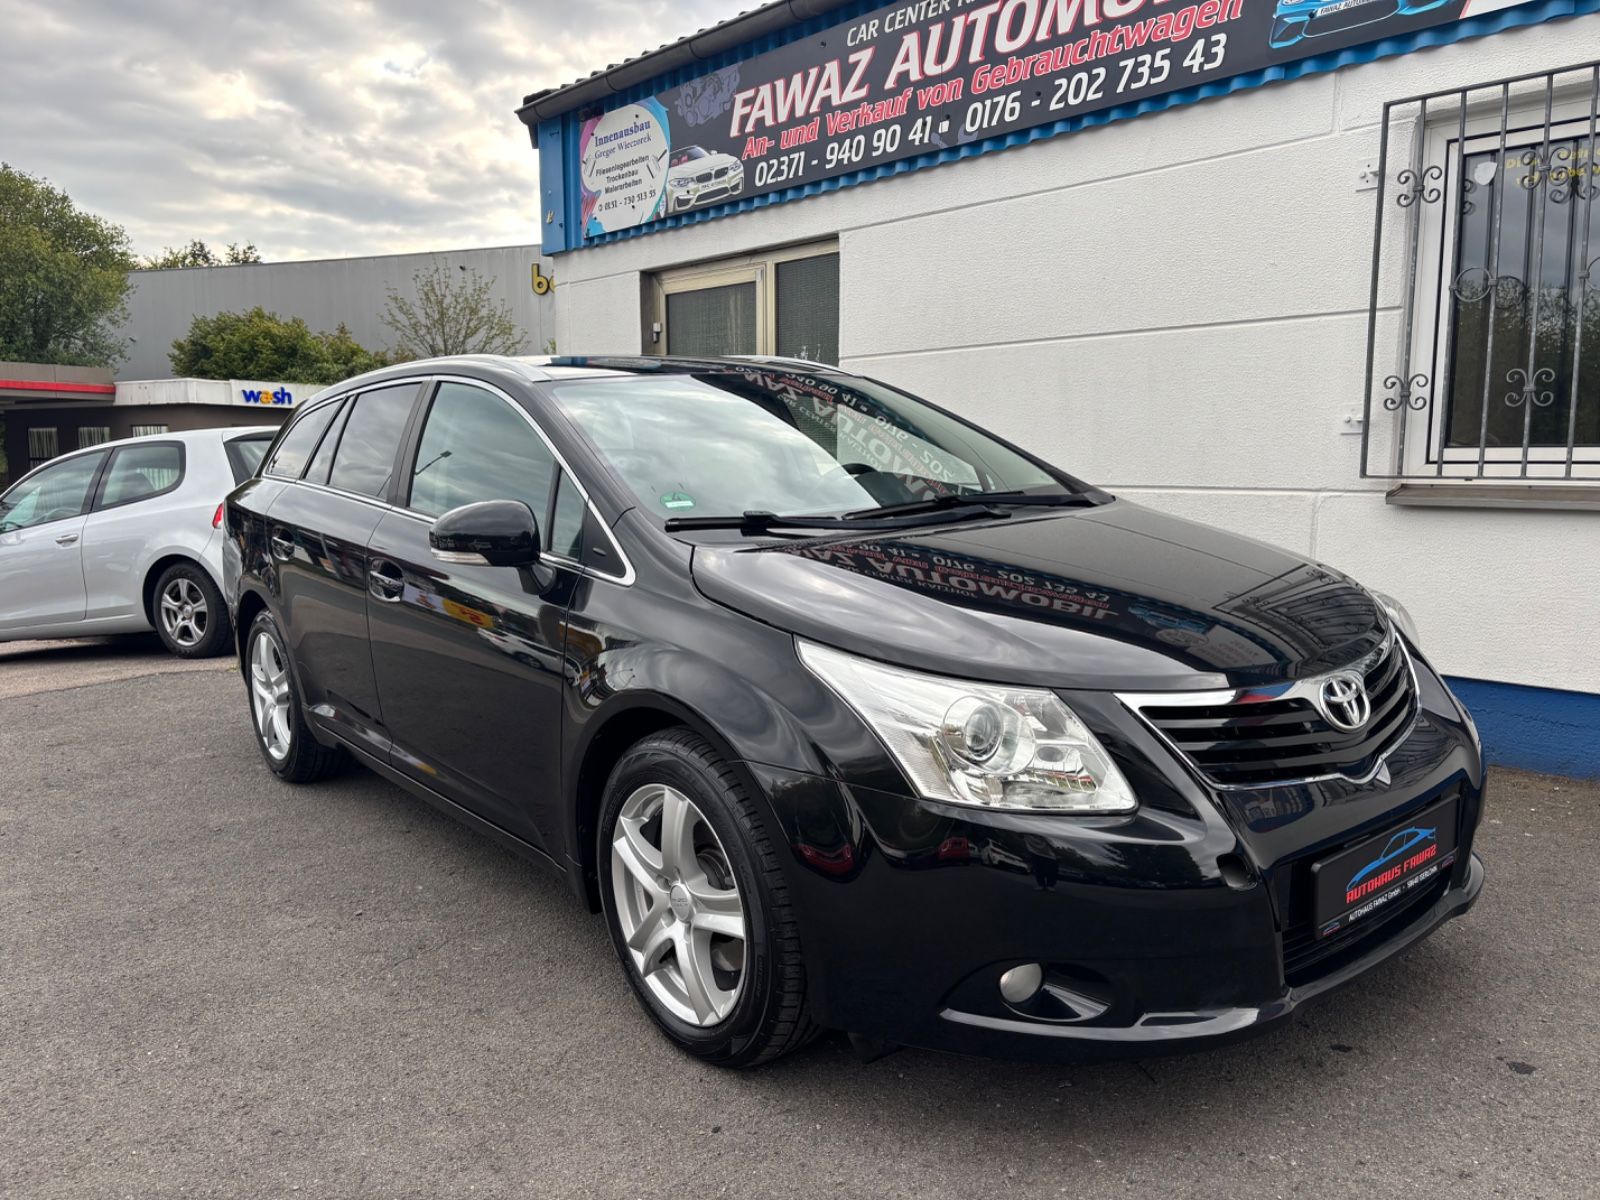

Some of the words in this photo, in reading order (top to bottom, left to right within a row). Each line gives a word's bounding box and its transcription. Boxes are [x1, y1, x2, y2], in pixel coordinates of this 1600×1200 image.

[846, 19, 879, 47] CAR
[884, 0, 952, 33] CENTER
[730, 46, 876, 138] FAWAZ
[743, 136, 775, 161] An-
[780, 120, 820, 150] und
[826, 86, 914, 136] Verkauf
[917, 77, 964, 111] von
[971, 0, 1243, 95] Gebrauchtwagen
[754, 151, 806, 187] 02371
[825, 135, 866, 169] 940
[872, 124, 901, 156] 90
[908, 116, 932, 146] 41
[965, 91, 1021, 132] 0176
[1050, 67, 1107, 111] 202
[1116, 48, 1171, 93] 735
[1183, 33, 1228, 74] 43
[594, 121, 651, 147] Innenausbau
[242, 386, 292, 405] wash
[1346, 865, 1402, 904] AUTOHAUS
[1404, 844, 1437, 873] FAWAZ
